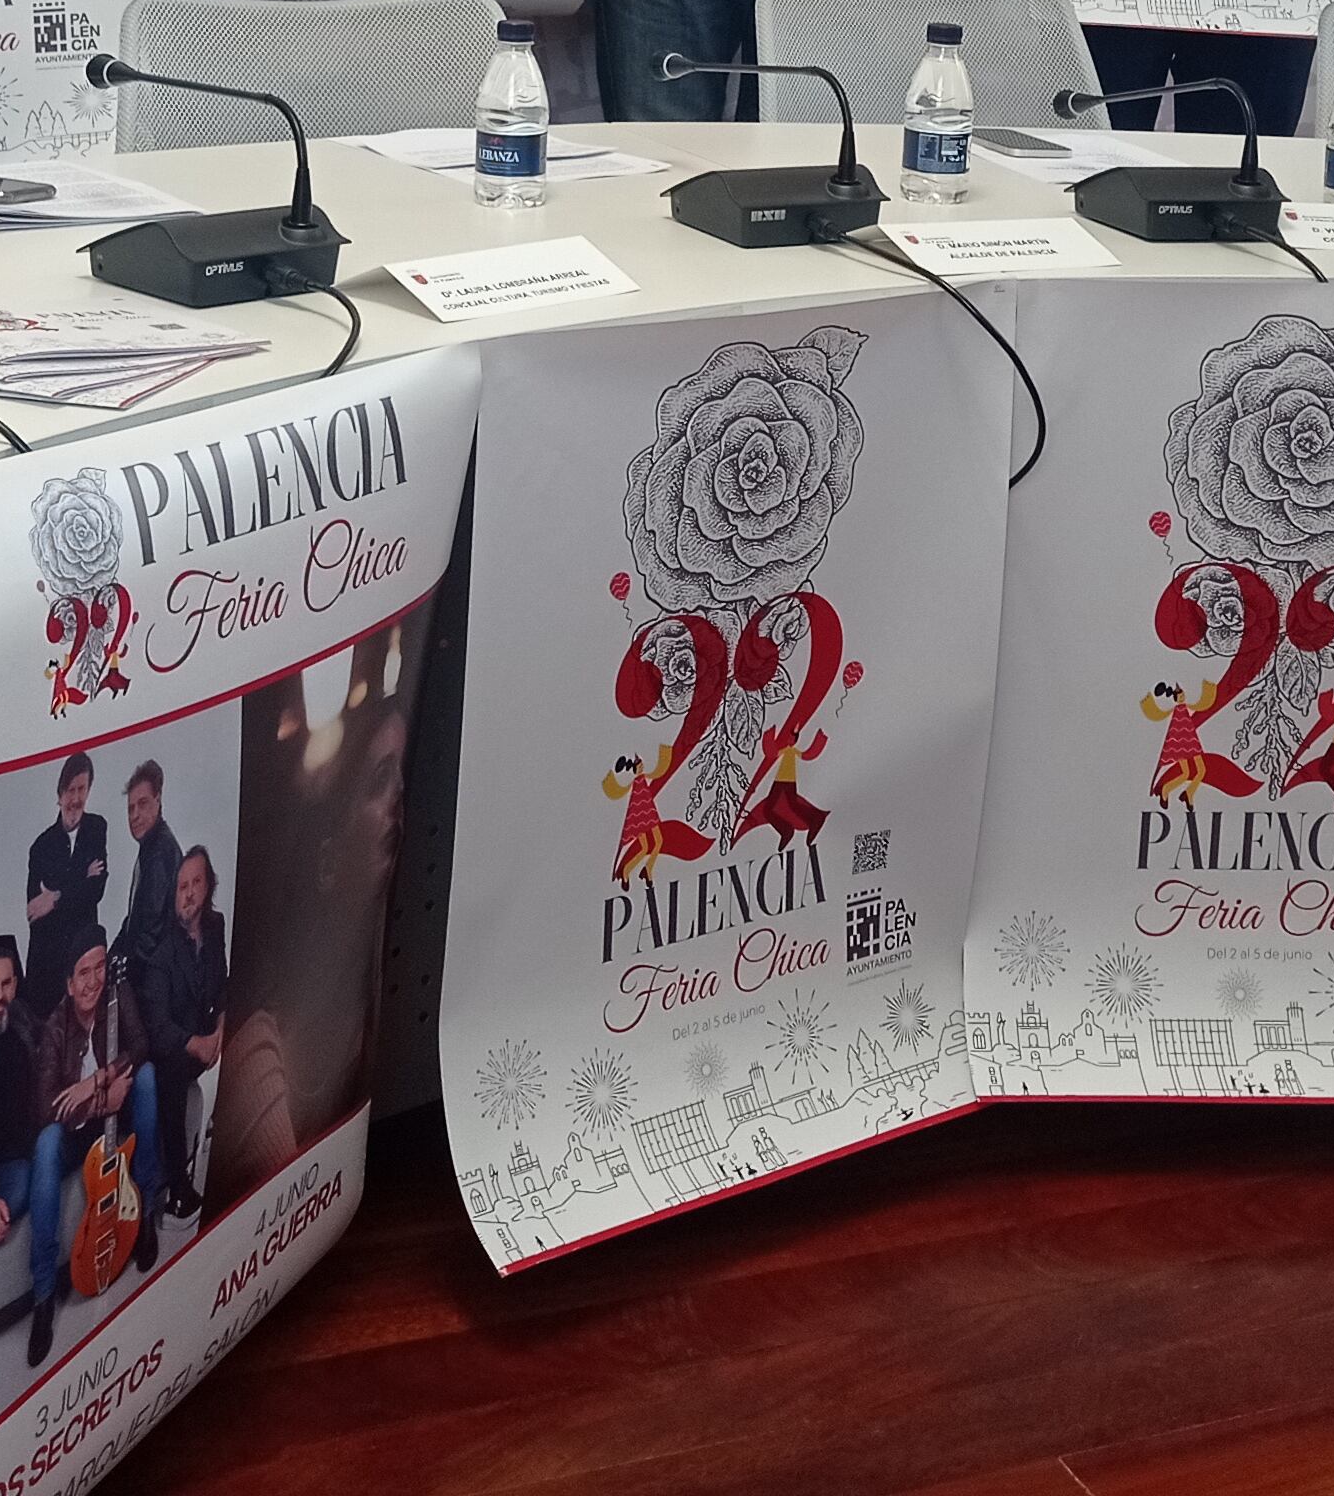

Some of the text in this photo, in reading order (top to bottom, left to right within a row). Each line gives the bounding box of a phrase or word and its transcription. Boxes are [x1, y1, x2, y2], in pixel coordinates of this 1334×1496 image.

[70, 12, 90, 25] PA
[71, 24, 100, 38] LEN
[71, 39, 98, 51] CIA
[35, 54, 94, 64] AYUNTAMIENT
[120, 396, 408, 568] PALENCIA
[144, 568, 289, 673] Feria
[303, 519, 408, 614] Chica
[613, 591, 844, 878] 22
[601, 844, 827, 964] PALENCIA
[884, 911, 917, 934] LEN
[885, 898, 906, 917] PA
[1134, 879, 1264, 937] Feria
[846, 949, 912, 977] AYUNTAMIENTO
[884, 930, 912, 951] CIA
[1207, 947, 1313, 963] Del 2 al 5 de junio
[603, 927, 831, 1034] Feria Chica
[254, 1161, 319, 1239] 4 JUNIO
[210, 1170, 343, 1320] ANA GUERRA
[29, 1338, 165, 1486] SECRETOS
[35, 1347, 118, 1439] 3 JUNIO
